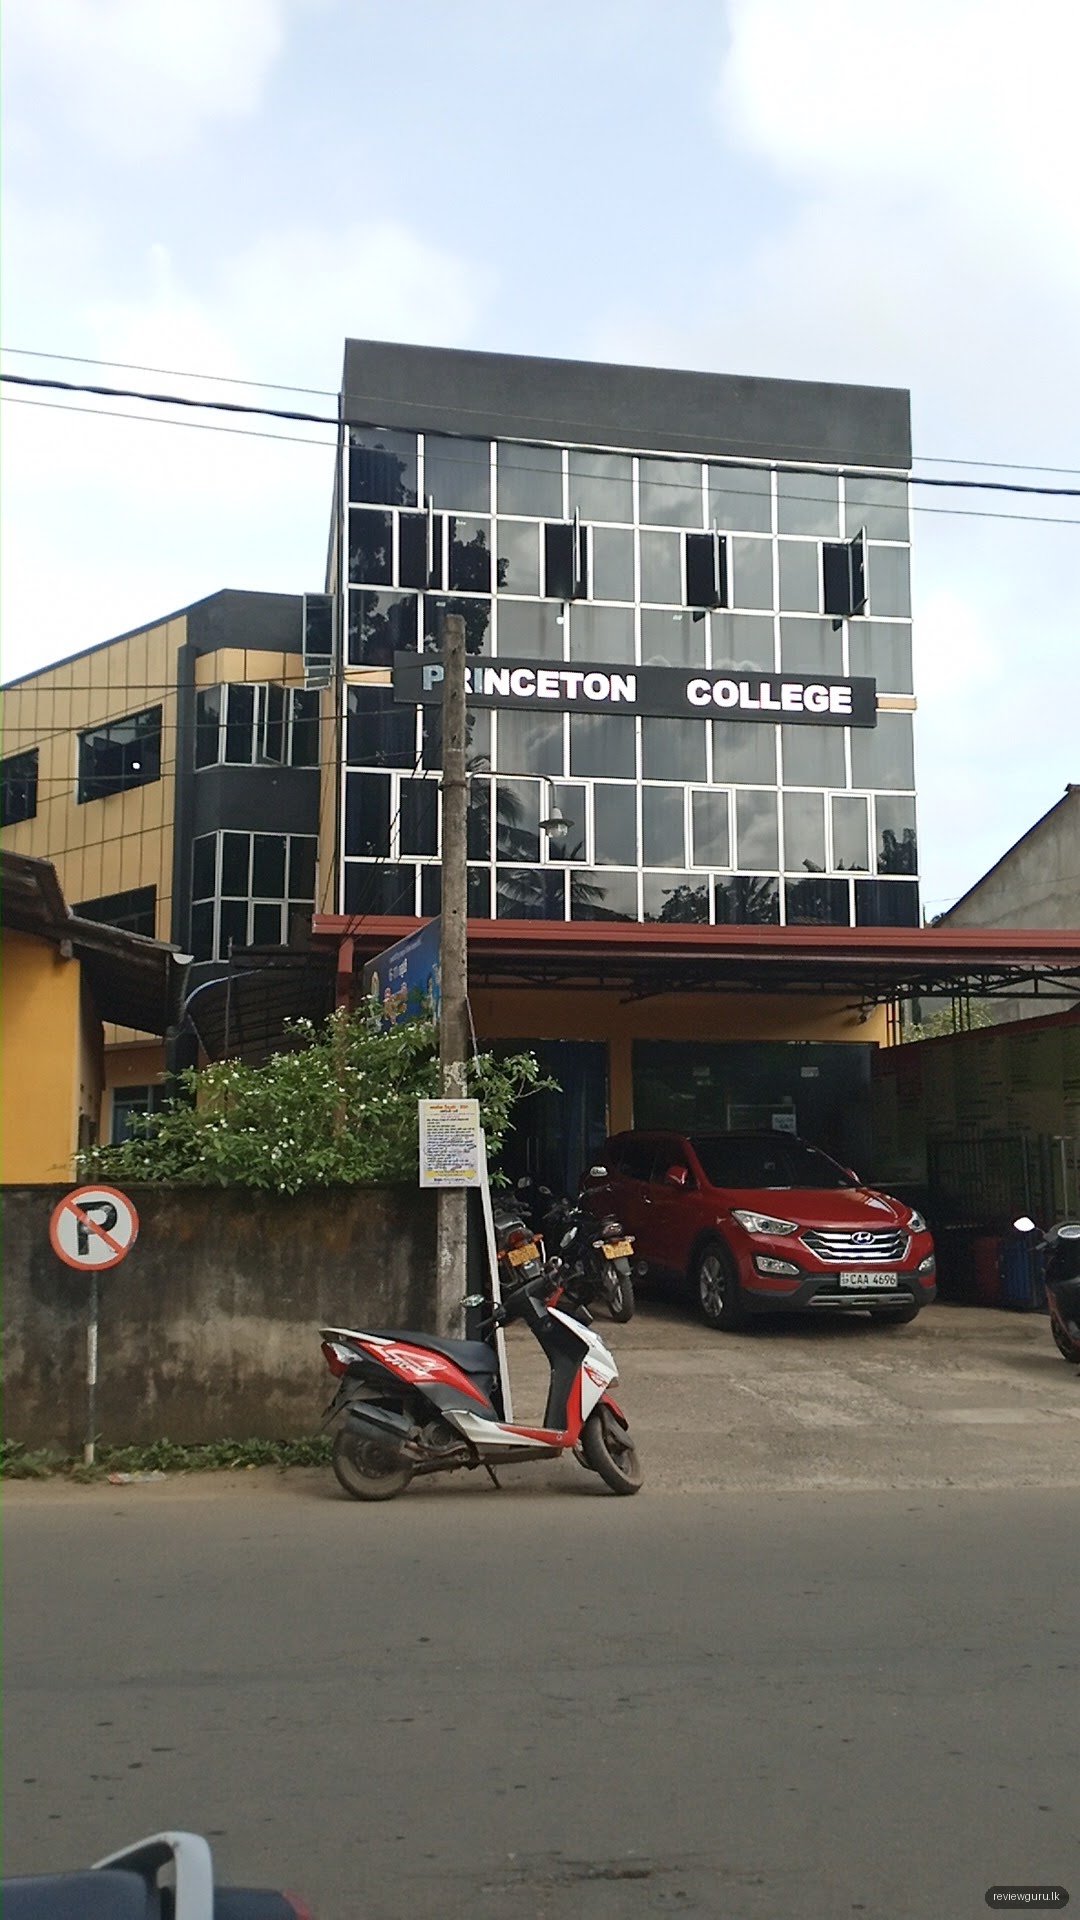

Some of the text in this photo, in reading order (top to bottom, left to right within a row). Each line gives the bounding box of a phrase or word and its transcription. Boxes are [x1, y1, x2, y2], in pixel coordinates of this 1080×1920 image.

[685, 678, 853, 714] COLLEGE
[76, 1201, 117, 1256] P
[850, 1274, 869, 1285] CAA
[873, 1274, 896, 1285] 4696
